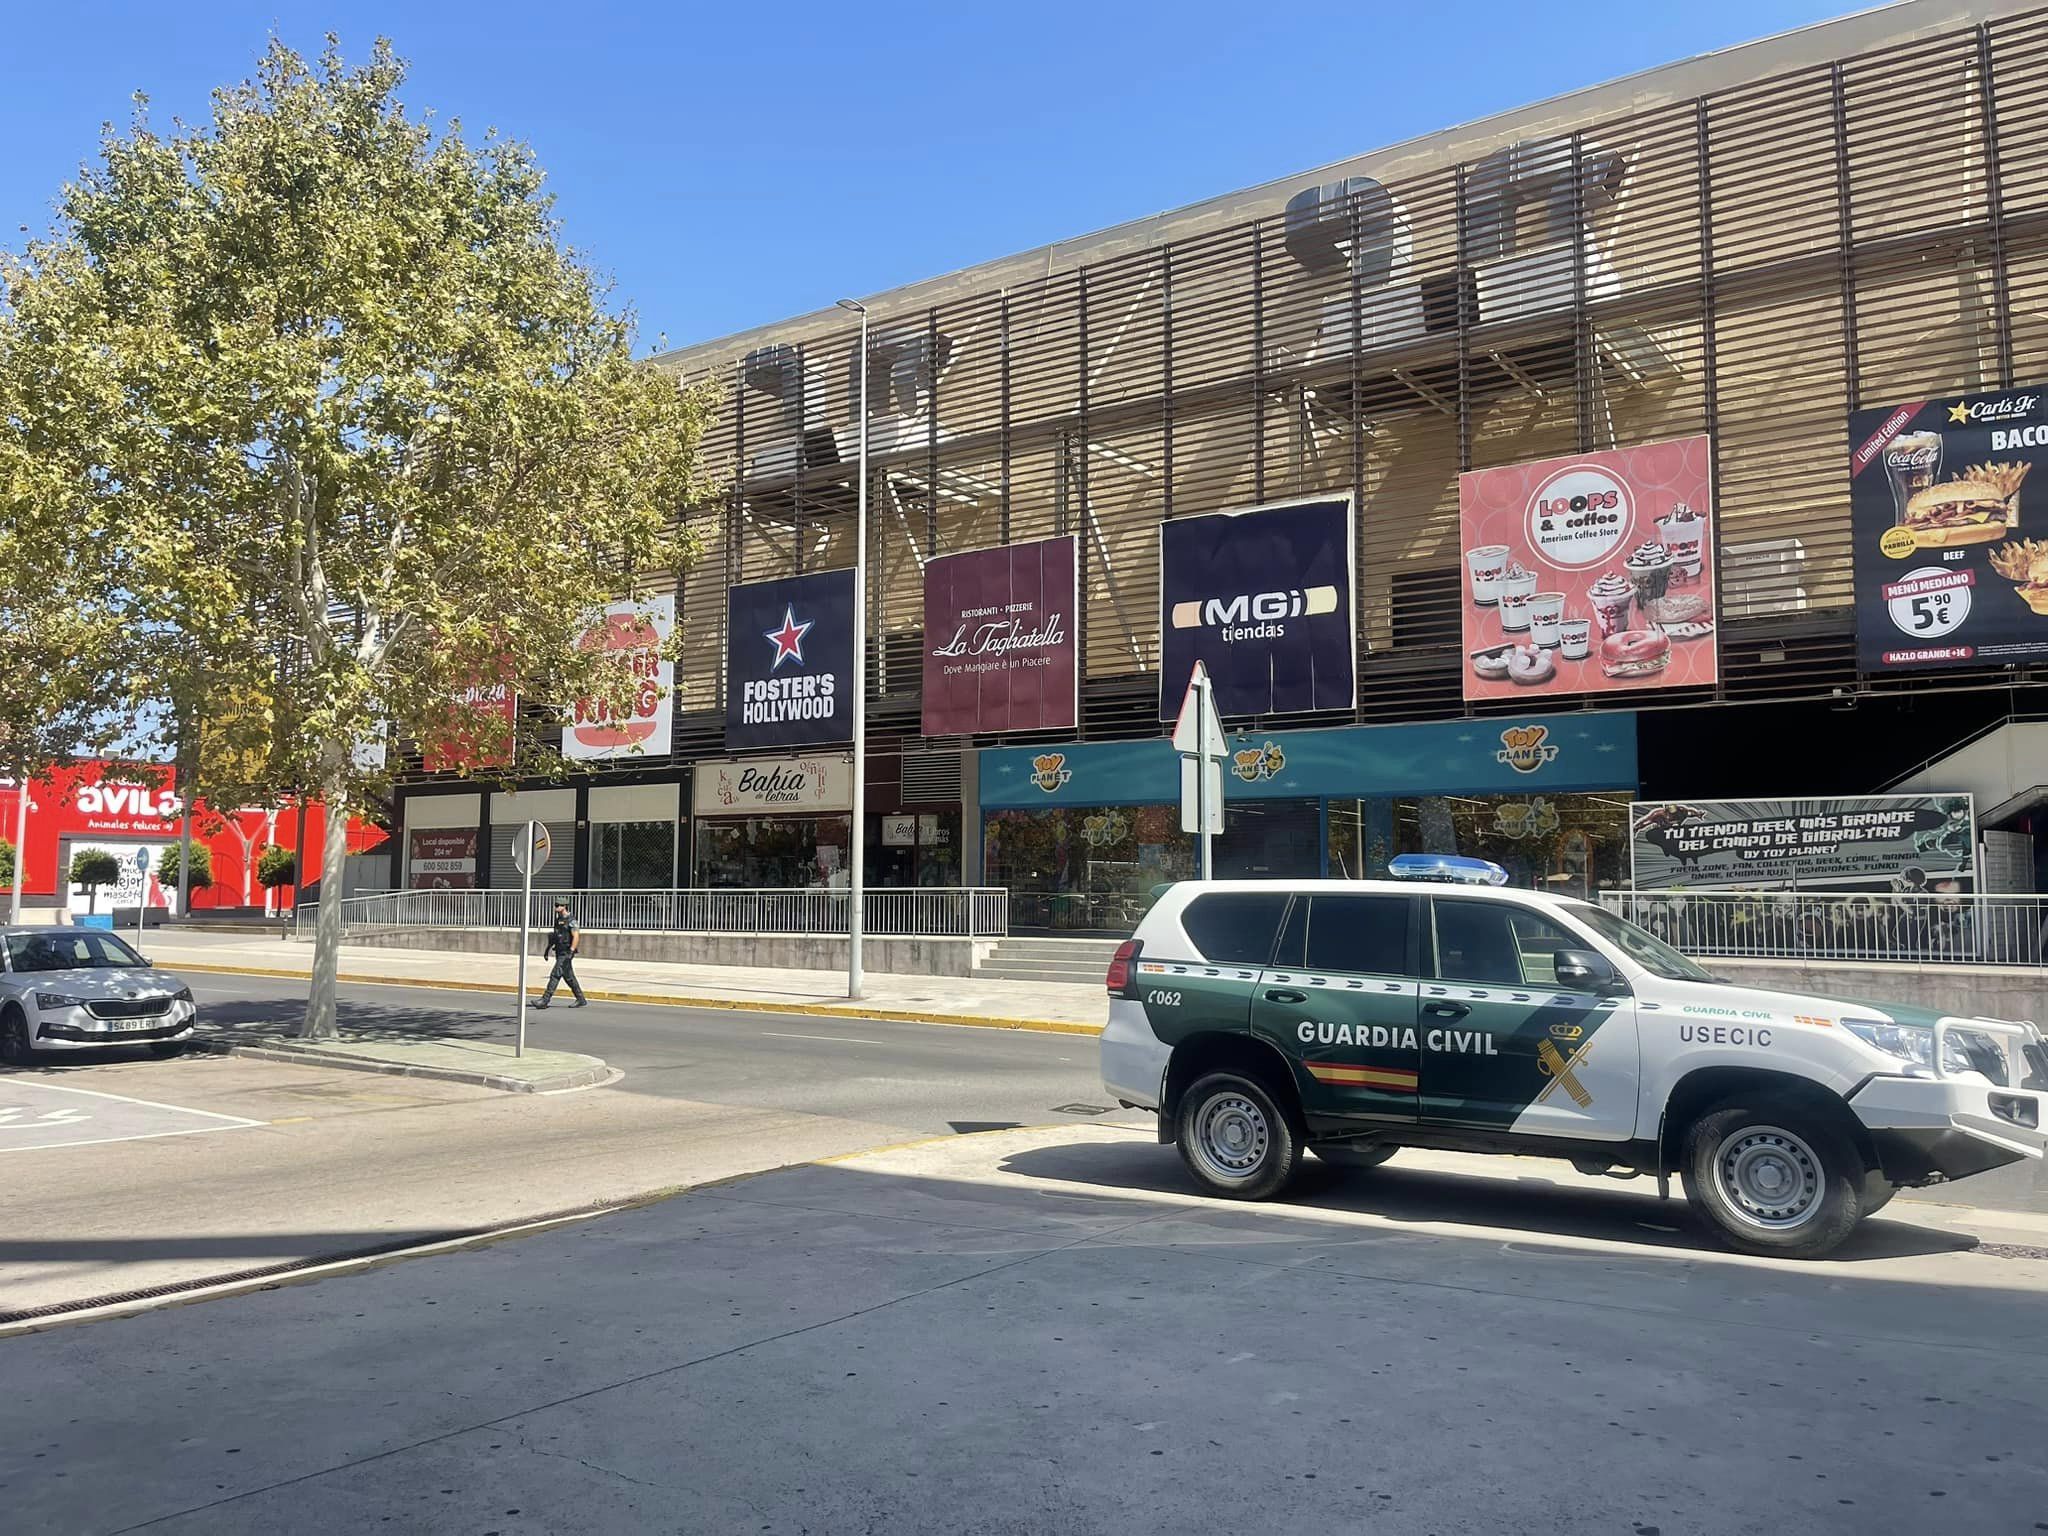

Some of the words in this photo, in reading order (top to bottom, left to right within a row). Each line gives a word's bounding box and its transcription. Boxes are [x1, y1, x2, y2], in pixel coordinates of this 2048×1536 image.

[1970, 398, 2013, 418] Carl's
[2014, 395, 2036, 412] Jr.
[1857, 433, 1886, 463] Limited
[1882, 411, 1909, 438] Edition
[1992, 425, 2048, 451] BACO
[1888, 446, 1939, 467] Coca-Cola
[1540, 491, 1618, 517] LOOPS
[1541, 519, 1554, 531] &
[1566, 512, 1618, 528] coffee
[1541, 534, 1573, 544] American
[1575, 530, 1598, 540] Coffee
[1600, 528, 1618, 537] Store
[1943, 551, 1965, 561] BEEF
[1888, 581, 1918, 597] MENÚ
[1919, 573, 1969, 591] MEDIANO
[961, 607, 997, 619] RISTORANTI
[1005, 602, 1033, 613] PIZZERIE
[932, 624, 967, 657] La
[968, 613, 1065, 657] Tagliatella
[1222, 622, 1285, 642] tiendas
[944, 664, 962, 675] Dove
[964, 661, 999, 674] Mangiare
[1010, 659, 1019, 668] un
[1022, 656, 1051, 667] Piacere
[1890, 651, 1916, 662] HAZLO
[1917, 649, 1951, 660] GRANDE
[743, 673, 834, 703] FOSTER'S
[743, 696, 834, 724] HOLLYWOOD
[1503, 727, 1545, 748] TOY
[1499, 745, 1556, 760] PLANET
[1035, 755, 1064, 771] TOY
[738, 765, 806, 792] Bahía
[1031, 770, 1069, 782] PLANET
[765, 789, 800, 802] letras
[88, 819, 129, 829] Animales
[133, 820, 161, 830] felices
[1664, 828, 1684, 839] TU
[1688, 822, 1748, 838] TIENDA
[1752, 819, 1796, 833] GEEK
[1800, 812, 1838, 829] MÁS
[1842, 811, 1916, 827] GRANDE
[422, 837, 437, 846] Local
[438, 837, 465, 847] disponible
[1679, 840, 1709, 851] DEL
[1713, 834, 1771, 849] CAMPO
[1775, 833, 1798, 845] DE
[1802, 826, 1901, 843] GIBRALTAR
[1744, 850, 1760, 859] BY
[1763, 848, 1786, 858] TOY
[1789, 844, 1837, 856] PLANET
[1156, 991, 1181, 1006] 062
[1683, 1006, 1738, 1016] GUARDIA
[1742, 1010, 1773, 1020] CIVIL
[1297, 1021, 1418, 1050] GUARDIA
[1427, 1028, 1498, 1056] CIVIL
[1680, 1025, 1772, 1047] USECIC
